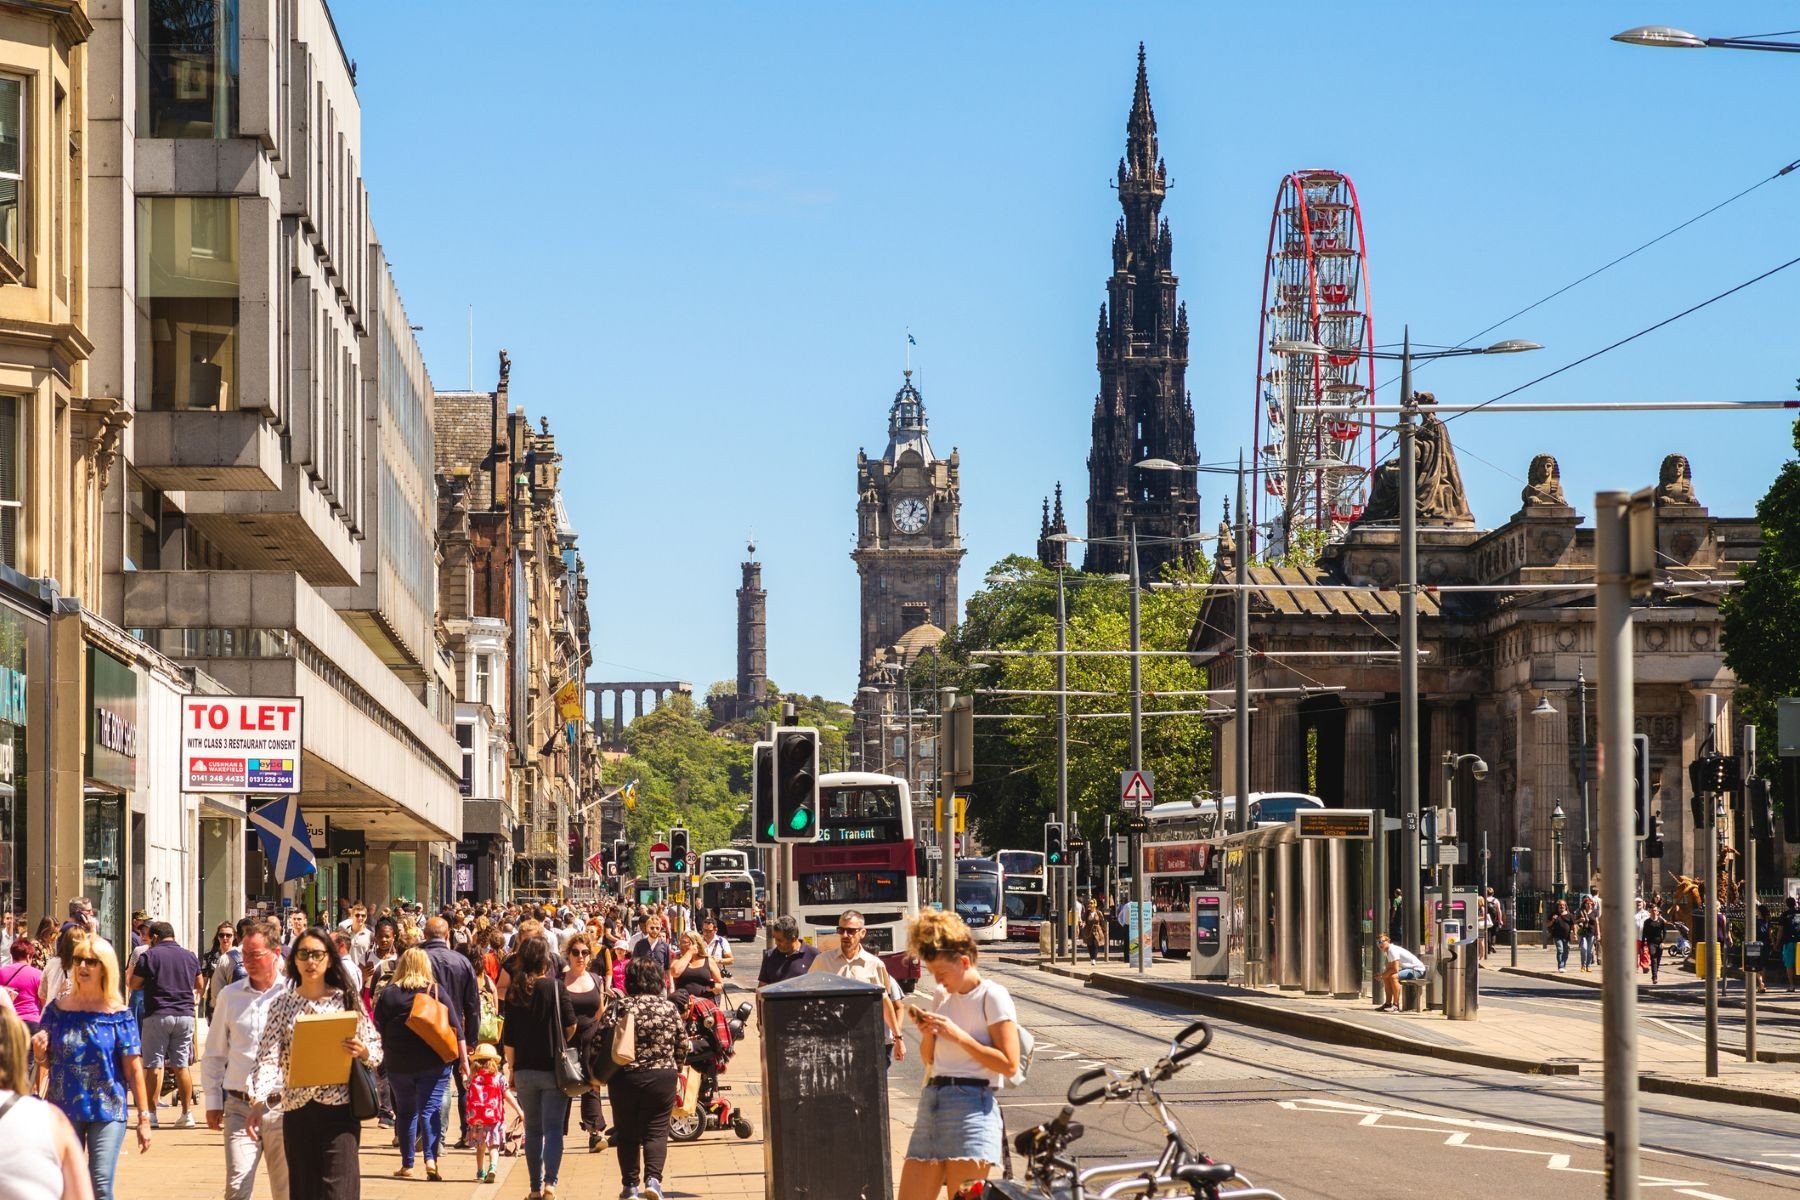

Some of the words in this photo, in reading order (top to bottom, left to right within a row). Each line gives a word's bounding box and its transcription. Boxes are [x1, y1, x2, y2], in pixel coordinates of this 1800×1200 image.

[189, 704, 229, 730] TO
[240, 705, 296, 731] LET
[101, 708, 111, 748] THE
[187, 738, 203, 748] WITH
[203, 738, 223, 749] CLASS
[223, 739, 228, 749] 3
[228, 739, 267, 750] RESTAURANT
[267, 740, 296, 750] CONSENT
[226, 775, 245, 783] 4433
[818, 828, 831, 840] 26
[838, 827, 875, 840] Tranent
